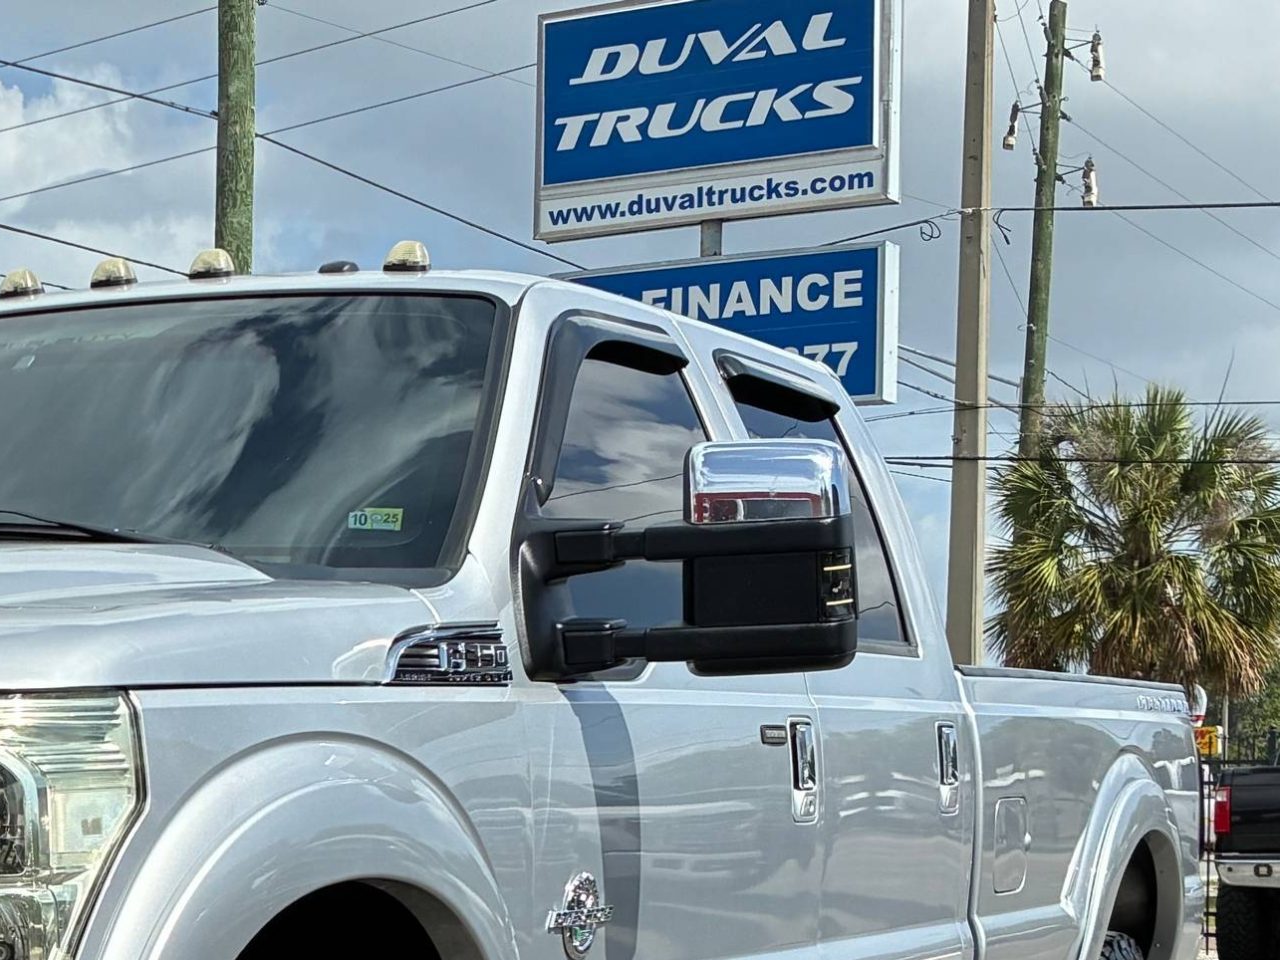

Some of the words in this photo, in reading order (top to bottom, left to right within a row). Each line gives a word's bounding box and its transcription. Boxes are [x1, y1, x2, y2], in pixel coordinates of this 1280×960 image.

[569, 12, 847, 85] DUVAL
[554, 76, 863, 152] TRUCKS
[548, 171, 874, 226] www.duvaltrucks.com
[641, 269, 864, 321] FINANCE
[351, 513, 368, 526] 10
[383, 513, 399, 524] 25
